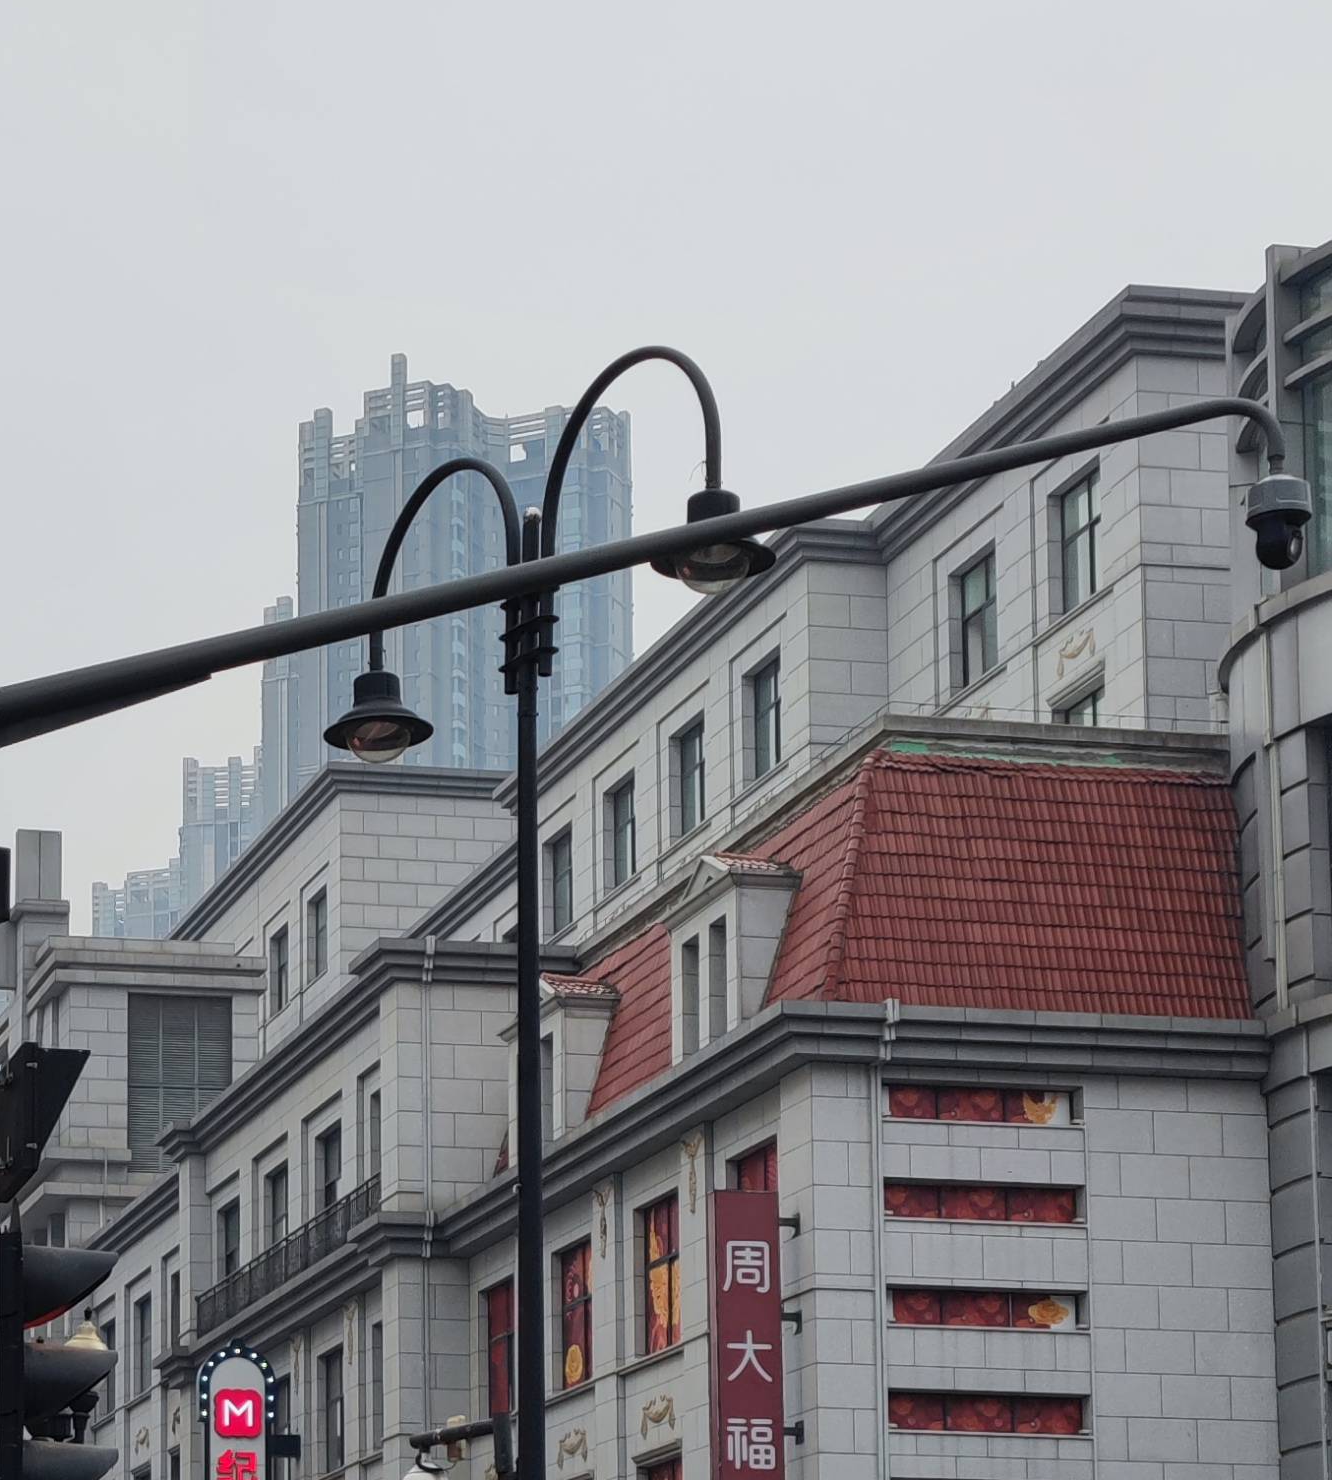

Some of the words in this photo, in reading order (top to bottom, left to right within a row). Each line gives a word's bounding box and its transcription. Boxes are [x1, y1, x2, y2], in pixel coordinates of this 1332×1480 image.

[222, 1398, 254, 1427] M
[723, 1240, 776, 1470] 周大福
